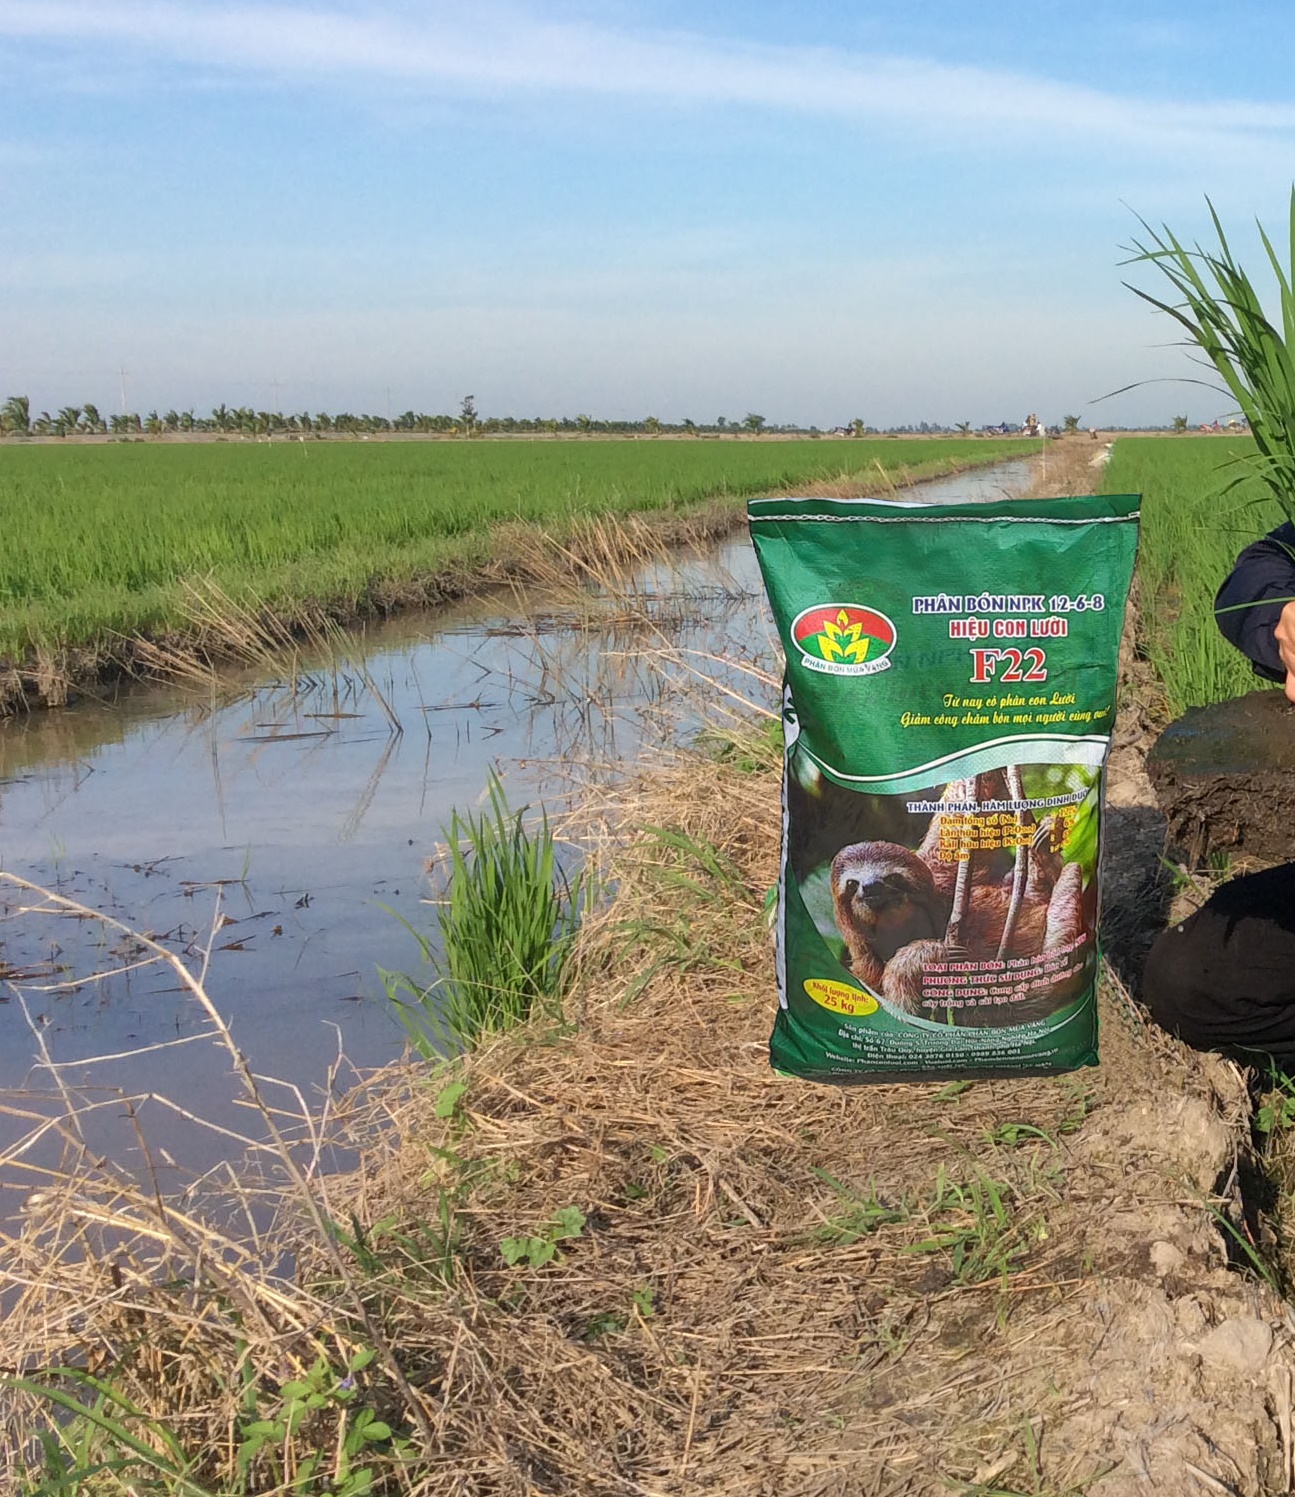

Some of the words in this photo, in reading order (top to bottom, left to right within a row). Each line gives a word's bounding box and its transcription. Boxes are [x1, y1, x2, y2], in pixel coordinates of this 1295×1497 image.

[913, 593, 962, 613] PHÂN
[965, 592, 1005, 613] BÓN
[1008, 595, 1045, 613] NPK
[1049, 594, 1105, 612] 12-6-8
[949, 616, 990, 641] HIỆU
[994, 619, 1027, 637] CON
[1030, 617, 1068, 637] LƯỜI
[970, 647, 1047, 683] F22
[943, 694, 960, 708] Từ
[962, 697, 982, 709] nay
[986, 694, 998, 706] có
[1000, 693, 1026, 709] phân
[1028, 696, 1046, 705] con
[1050, 692, 1076, 705] Lười
[901, 711, 931, 728] Giảm
[933, 713, 958, 728] công
[961, 712, 990, 725] chăm
[992, 711, 1010, 724] bón
[1013, 711, 1033, 726] mọi
[1036, 709, 1066, 724] người
[1069, 708, 1091, 723] cùng
[906, 800, 945, 813] THÀNH
[982, 800, 1007, 812] HÀM
[1045, 795, 1070, 807] DINH
[923, 962, 948, 974] LOẠI
[950, 961, 978, 972] PHÂN
[922, 988, 953, 998] CÔNG
[824, 994, 838, 1007] 25
[841, 1000, 855, 1014] kg
